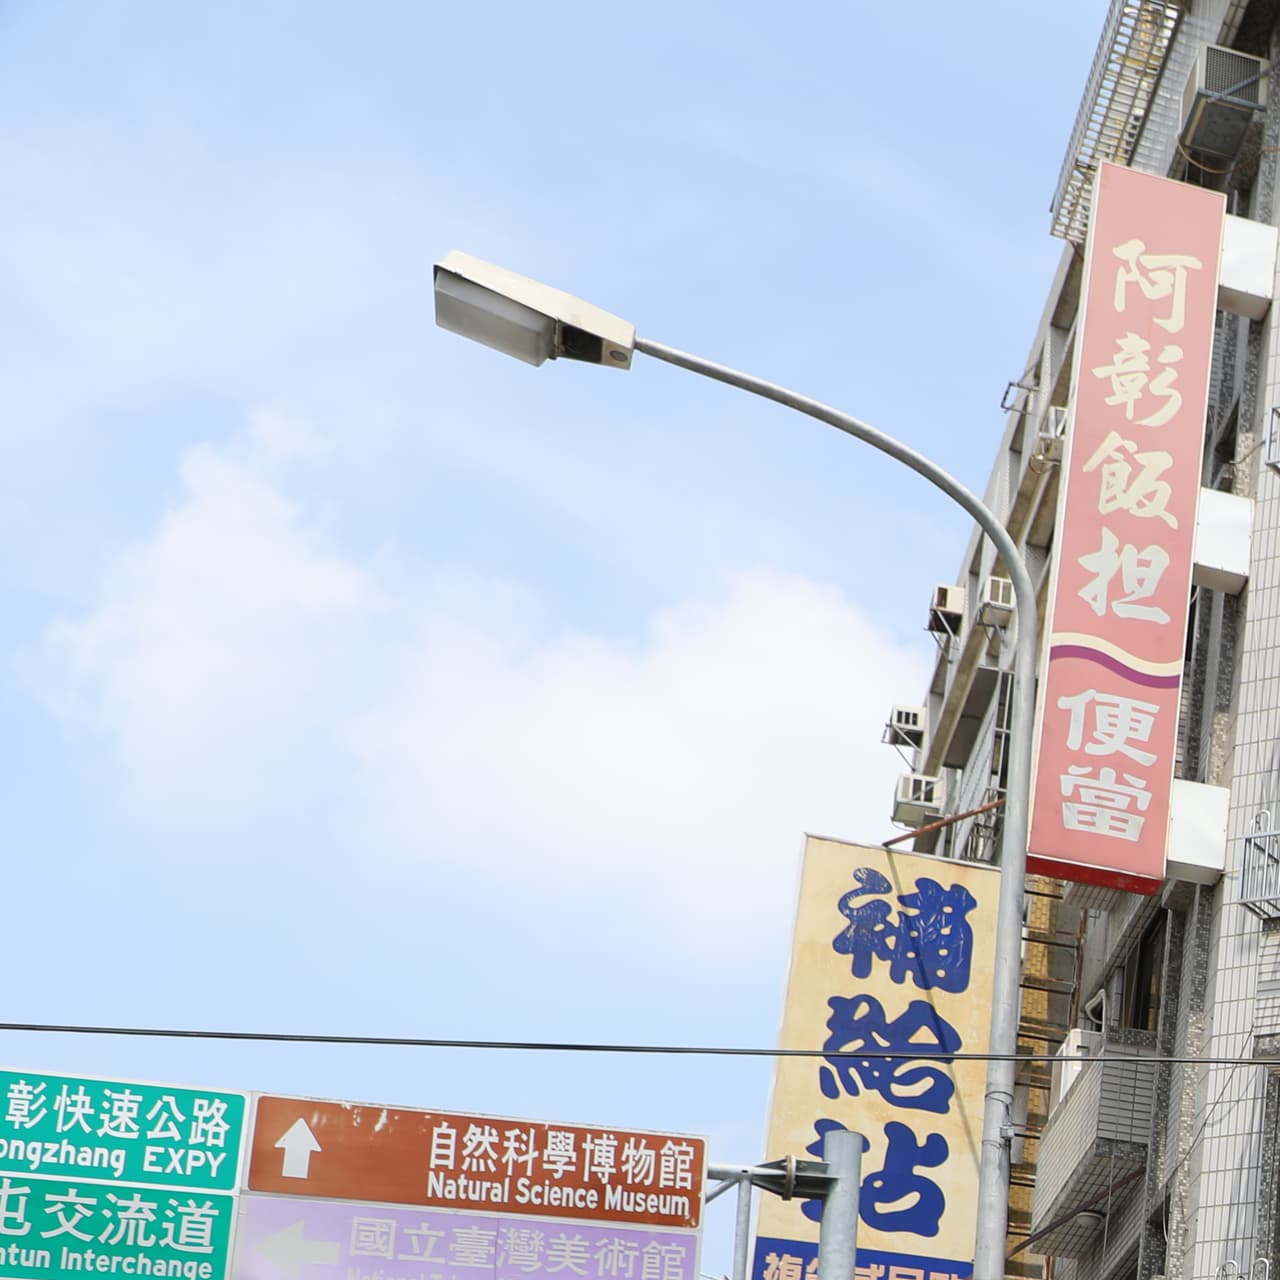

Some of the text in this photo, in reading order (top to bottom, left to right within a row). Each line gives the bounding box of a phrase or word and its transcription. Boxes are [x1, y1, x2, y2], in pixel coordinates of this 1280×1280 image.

[1056, 239, 1202, 844] 阿彰飯担 便當
[801, 867, 977, 1237] 補給站
[5, 1080, 230, 1147] 彰快速公路
[143, 1146, 227, 1177] EXPY
[429, 1121, 694, 1190] 自然科學博物館
[427, 1172, 690, 1217] Natural Science Museum
